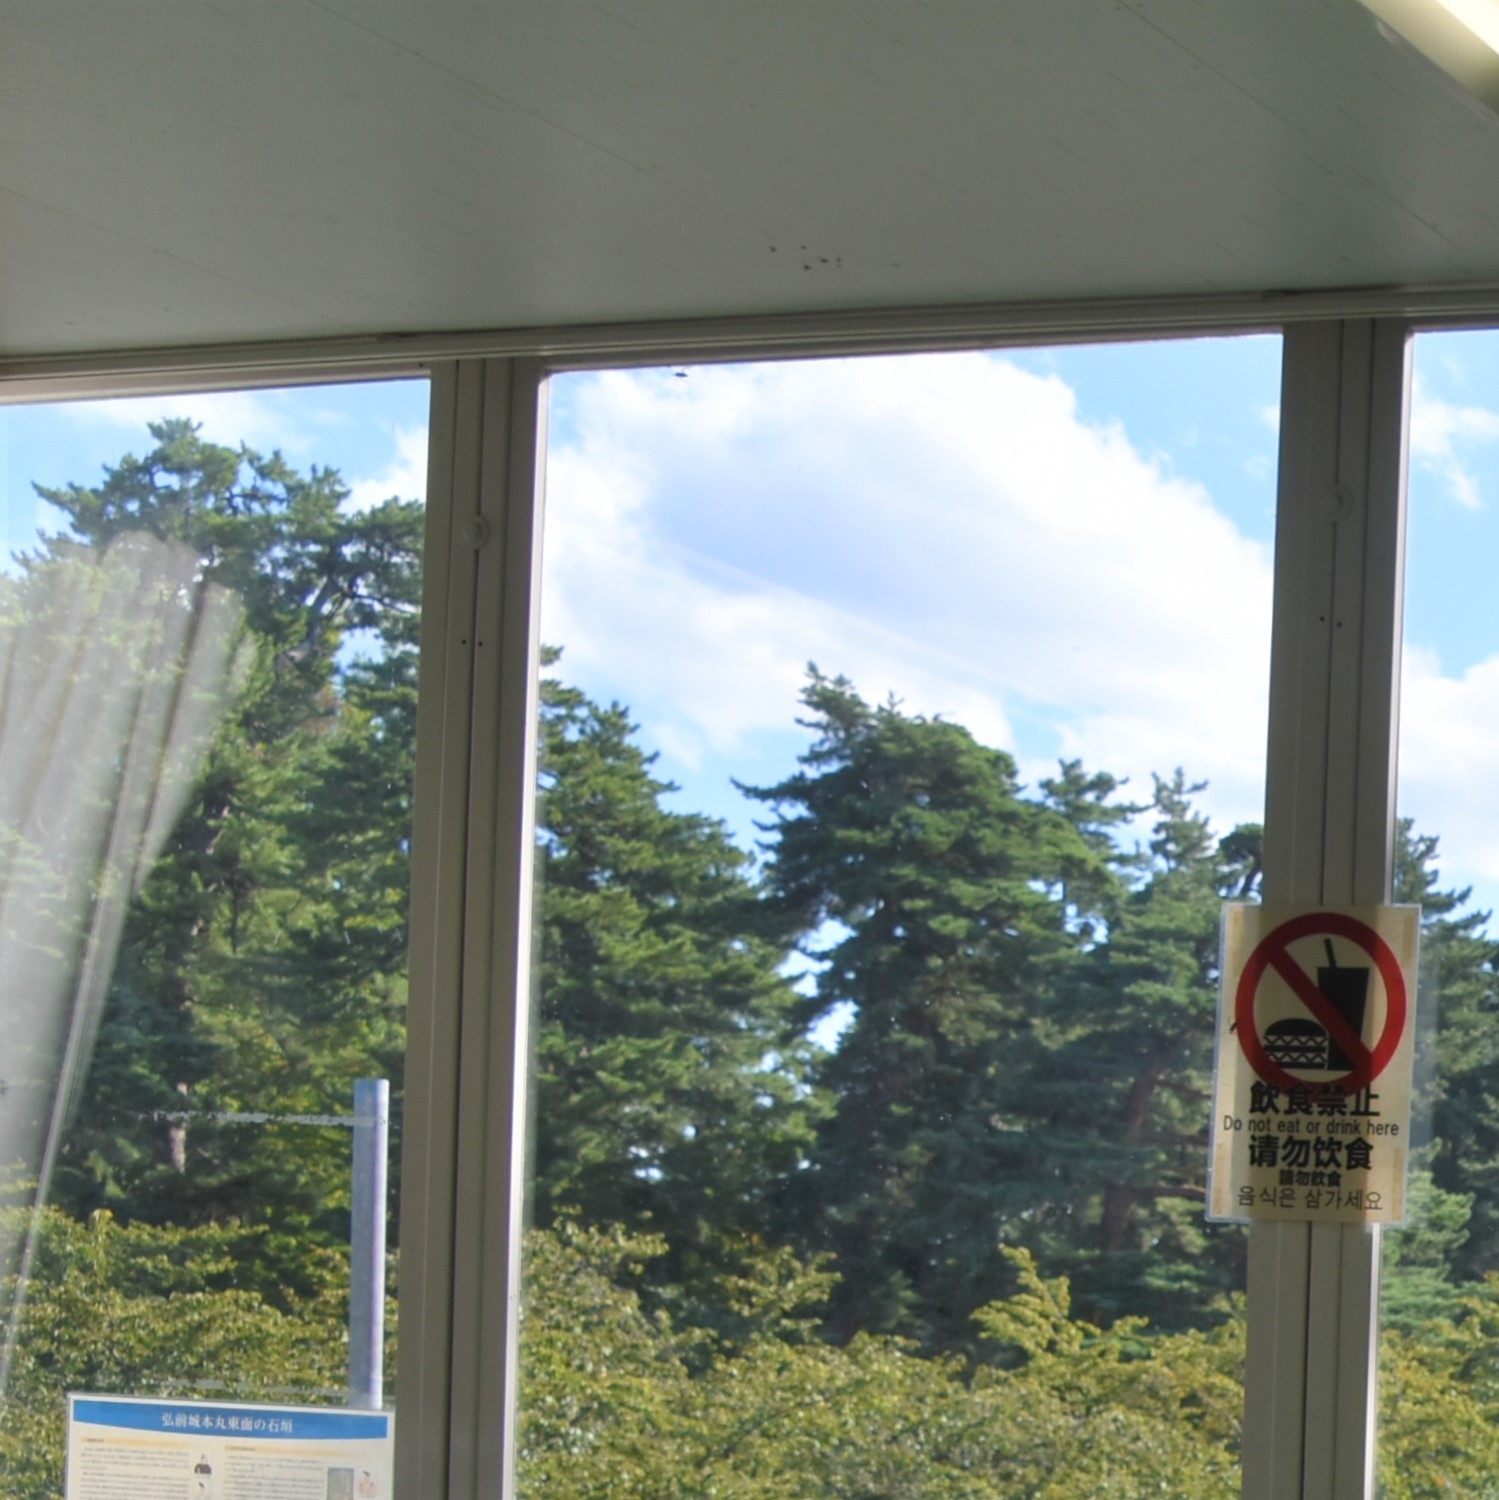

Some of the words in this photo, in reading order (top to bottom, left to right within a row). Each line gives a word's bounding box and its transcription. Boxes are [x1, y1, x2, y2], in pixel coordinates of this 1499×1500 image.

[1250, 1080, 1381, 1117] 飲食禁止
[1223, 1115, 1243, 1131] Do
[1248, 1117, 1271, 1132] not
[1277, 1118, 1301, 1133] eat
[1306, 1121, 1321, 1134] or
[1326, 1118, 1361, 1135] drink
[1366, 1119, 1400, 1136] here
[1248, 1135, 1374, 1170] 请勿饮食
[1279, 1170, 1342, 1187] 請勿飲食
[1238, 1186, 1297, 1208] 음식은
[1305, 1188, 1383, 1211] 삼가세요
[161, 1411, 294, 1434] 弘前城本丸東面の石垣
